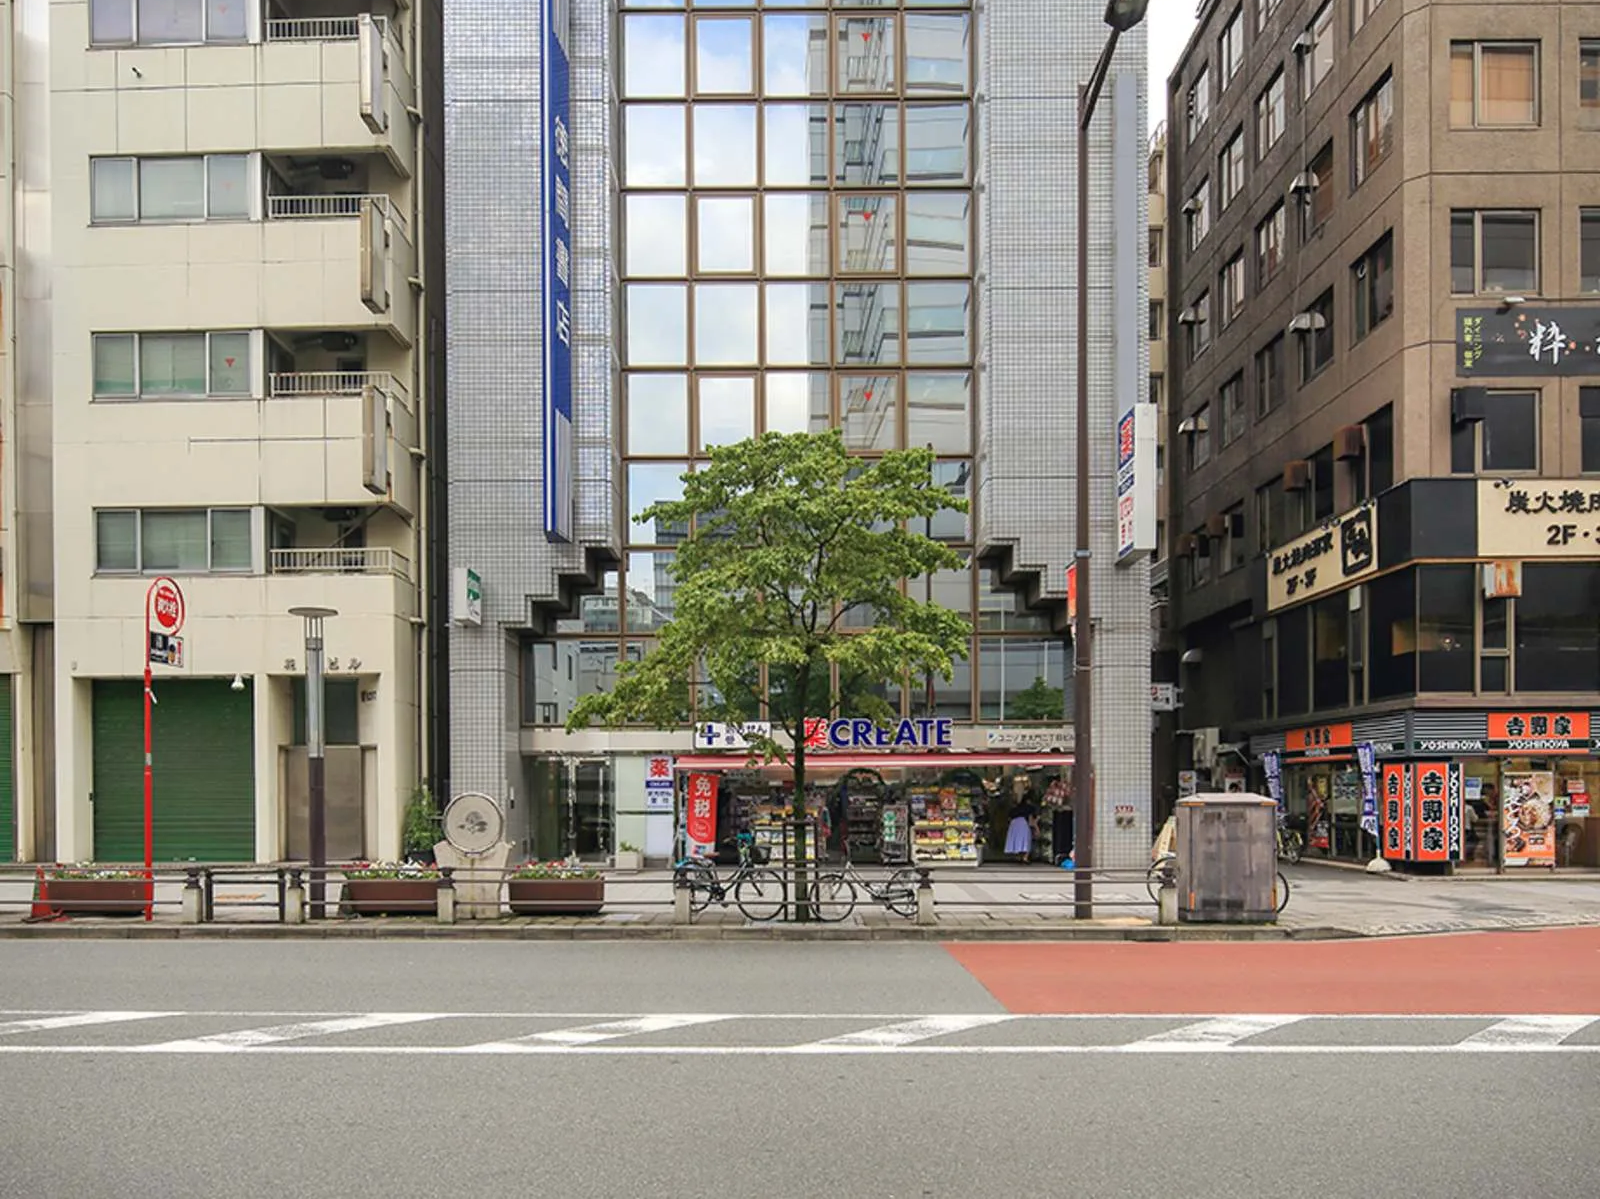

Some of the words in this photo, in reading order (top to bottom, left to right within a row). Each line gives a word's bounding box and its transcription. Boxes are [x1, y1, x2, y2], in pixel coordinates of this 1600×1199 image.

[829, 718, 953, 748] CREATE
[1505, 715, 1573, 737] 吉野家
[1420, 741, 1483, 751] YOSHINOYA
[1508, 739, 1570, 750] YOSHINOYA
[694, 776, 712, 818] 免税
[1420, 770, 1445, 852] 吉野家
[1449, 771, 1459, 851] YOSHINOYA
